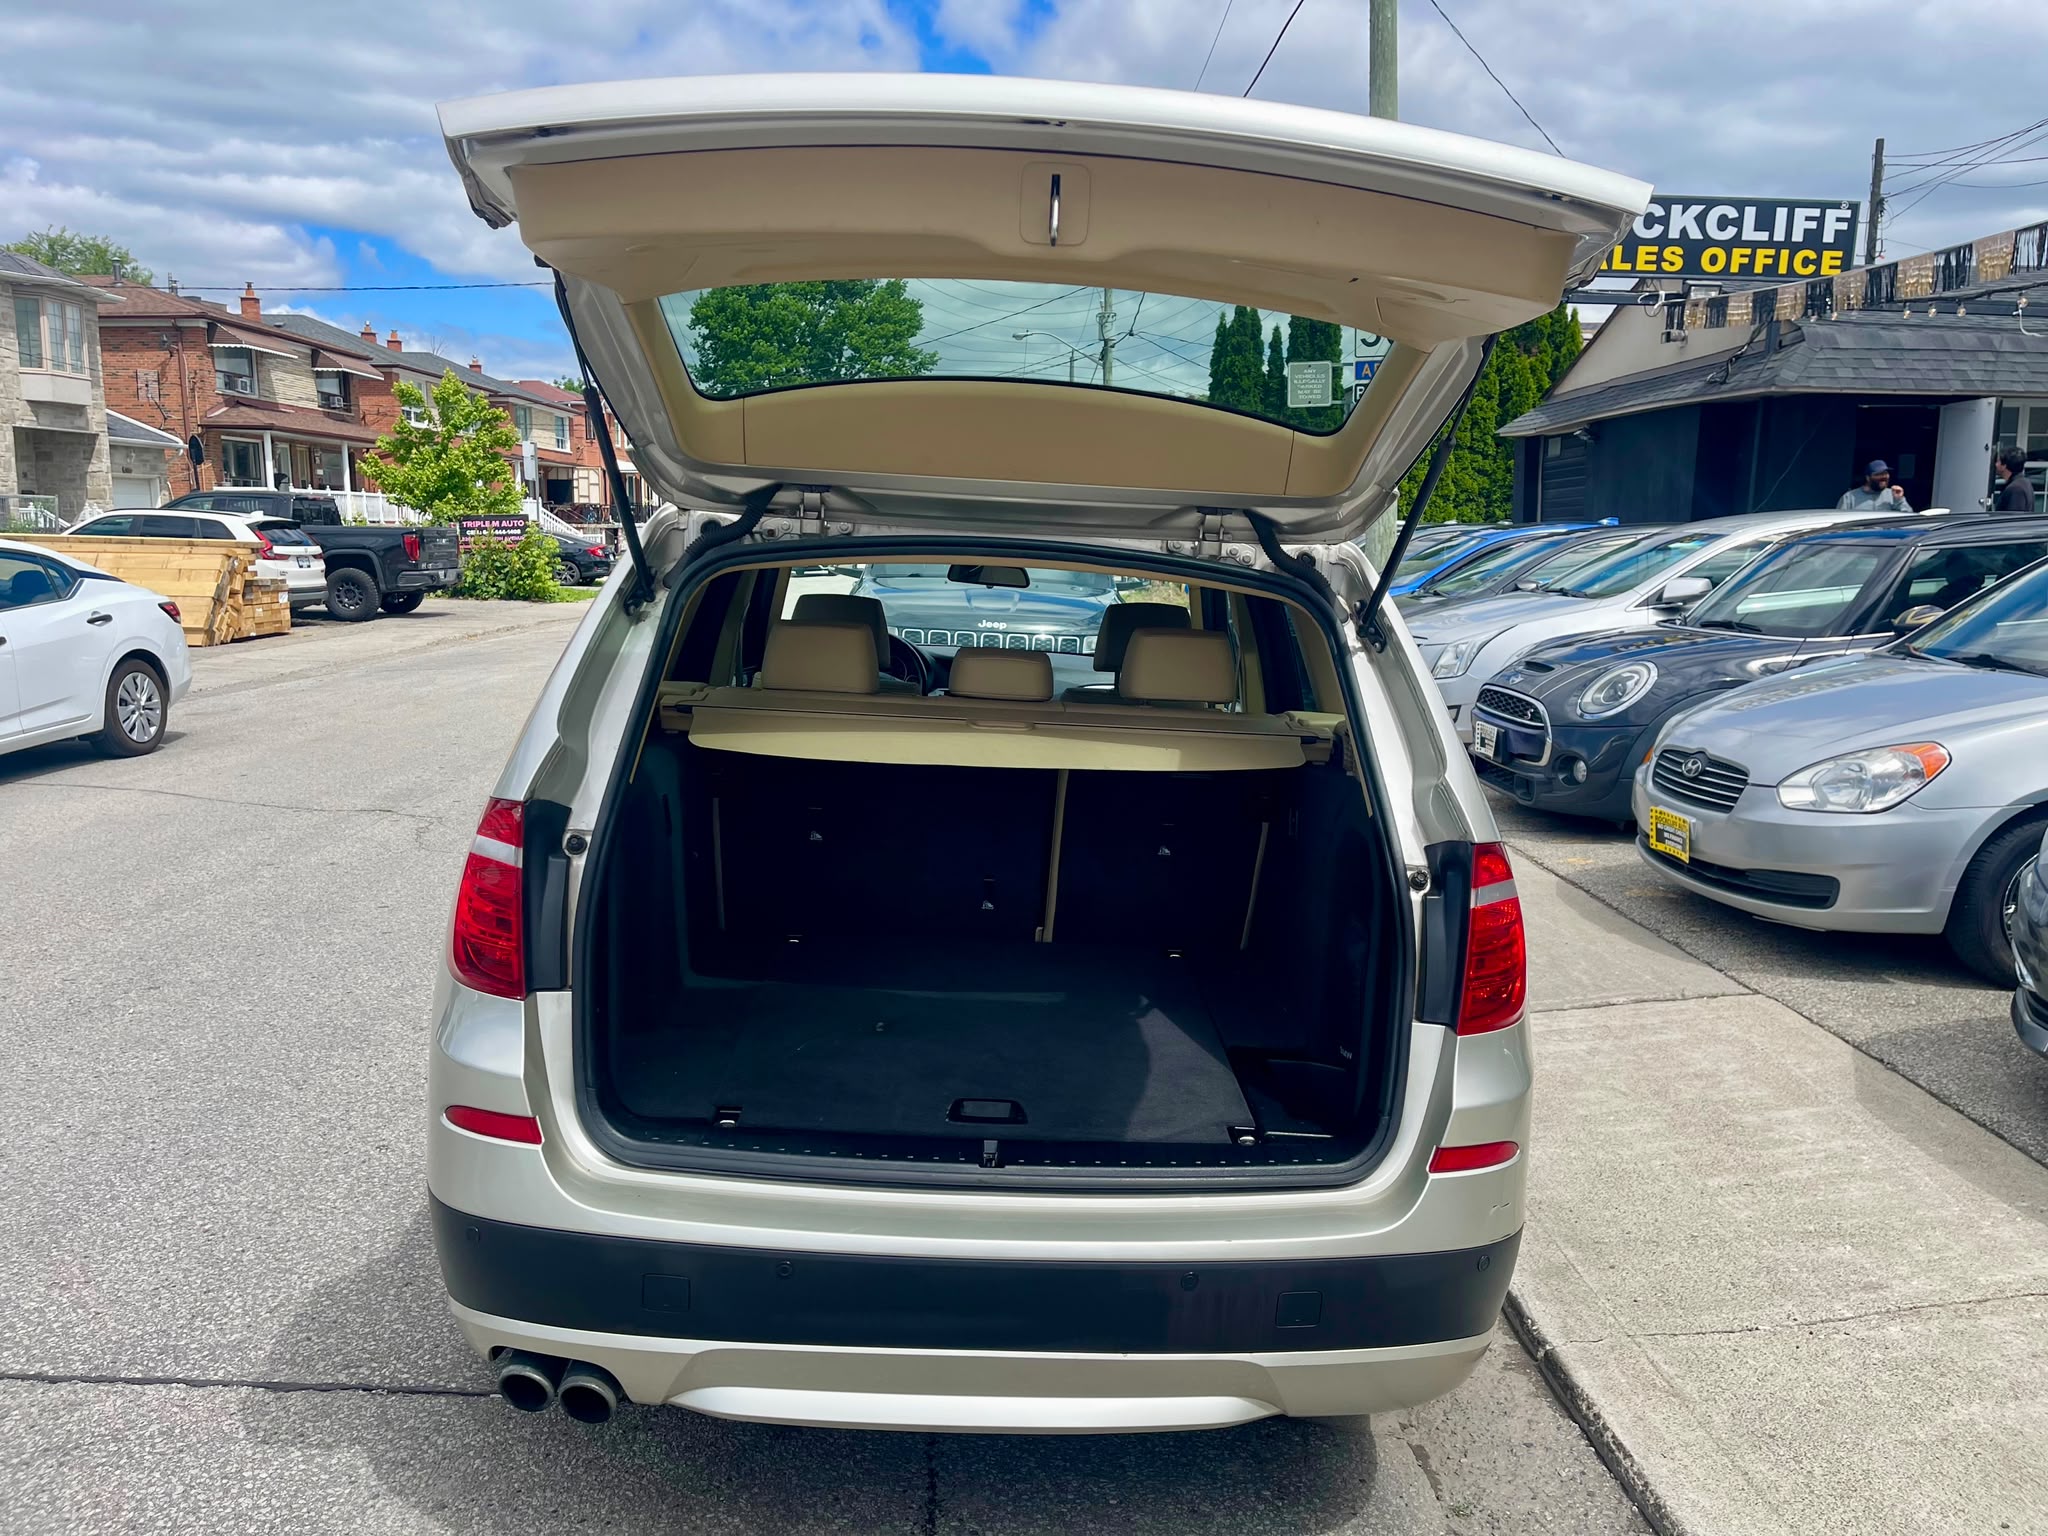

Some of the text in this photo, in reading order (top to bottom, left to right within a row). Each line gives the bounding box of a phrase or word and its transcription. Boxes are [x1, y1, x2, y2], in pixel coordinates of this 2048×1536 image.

[1700, 245, 1844, 276] OFFICE
[462, 519, 525, 528] TRIPLE M AUTO
[978, 619, 1007, 630] Jeep
